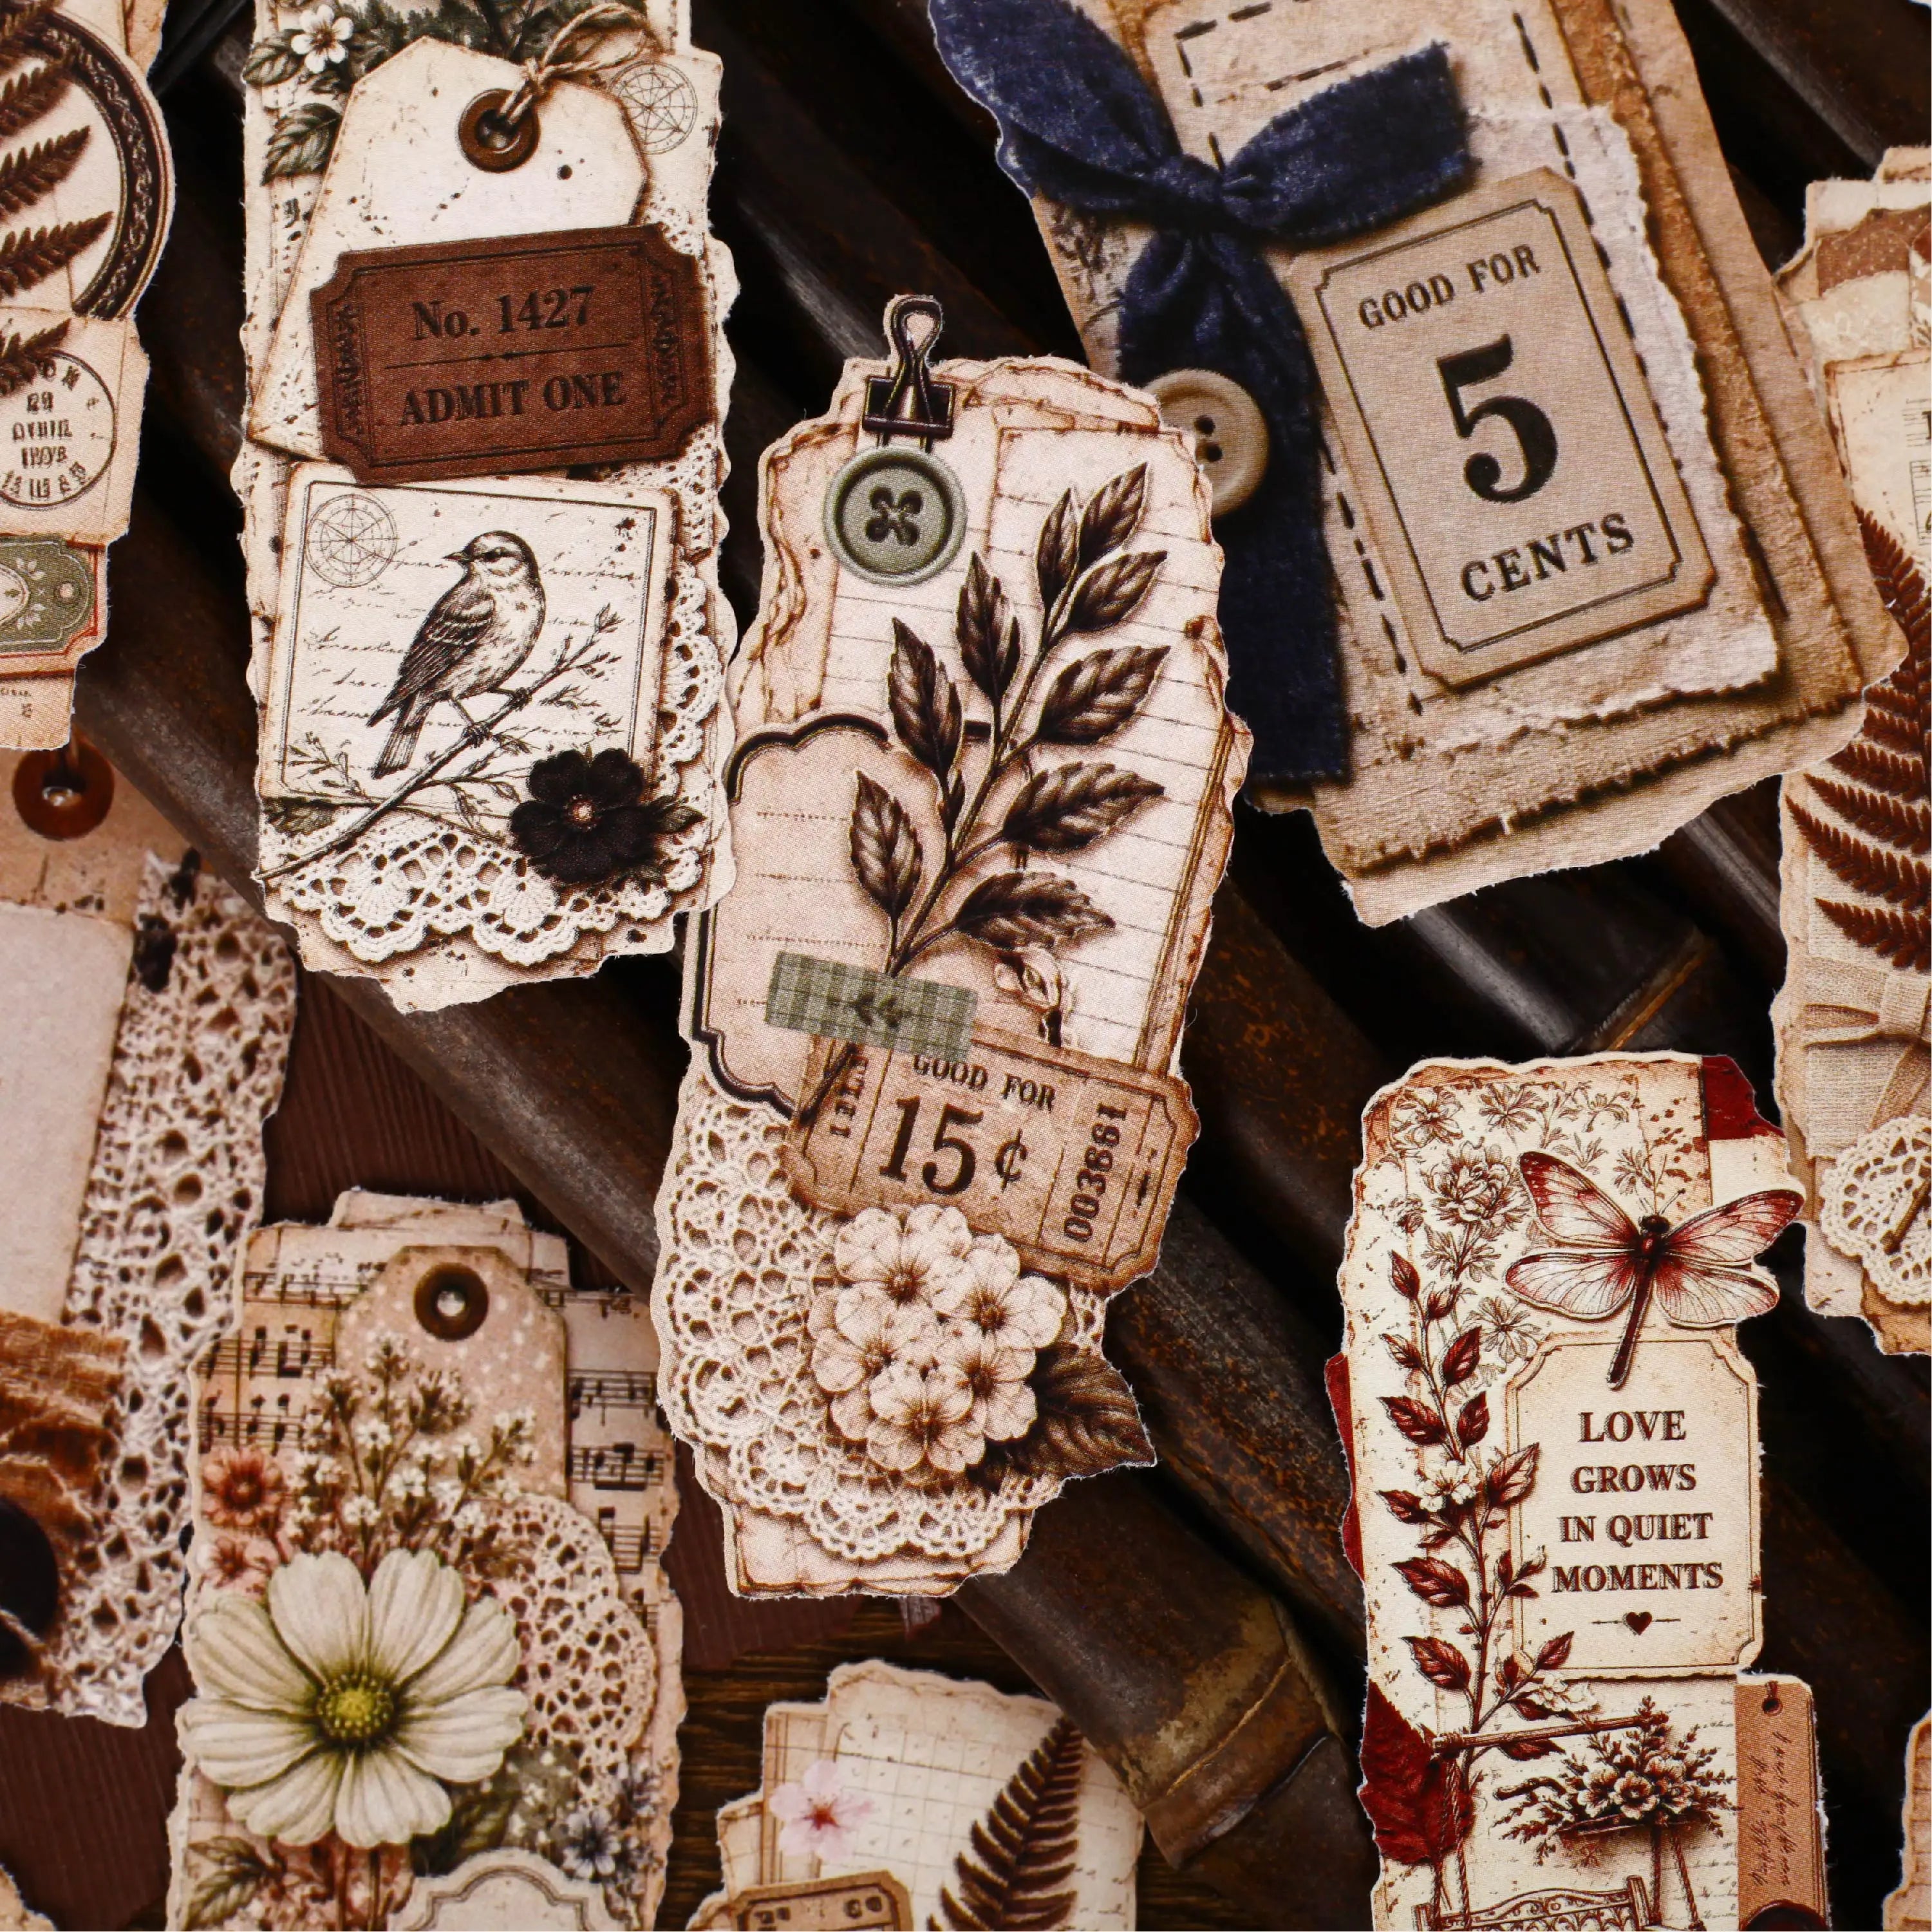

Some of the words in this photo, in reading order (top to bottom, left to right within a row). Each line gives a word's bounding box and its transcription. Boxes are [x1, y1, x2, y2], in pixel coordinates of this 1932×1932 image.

[412, 298, 480, 342] No.
[497, 284, 596, 335] 1427
[1358, 273, 1456, 330] GOOD
[1465, 243, 1541, 294] FOR
[400, 379, 529, 427] ADMIT
[543, 370, 625, 411] ONE
[1436, 333, 1559, 504] 5
[1460, 512, 1635, 603] CENTS
[913, 1055, 989, 1093] GOOD
[1000, 1071, 1056, 1114] FOR
[1577, 1410, 1687, 1443] LOVE
[1570, 1463, 1698, 1494] GROWS
[1557, 1515, 1597, 1543] IN
[1606, 1512, 1714, 1548] QUIET
[1550, 1562, 1724, 1593] MOMENTS
